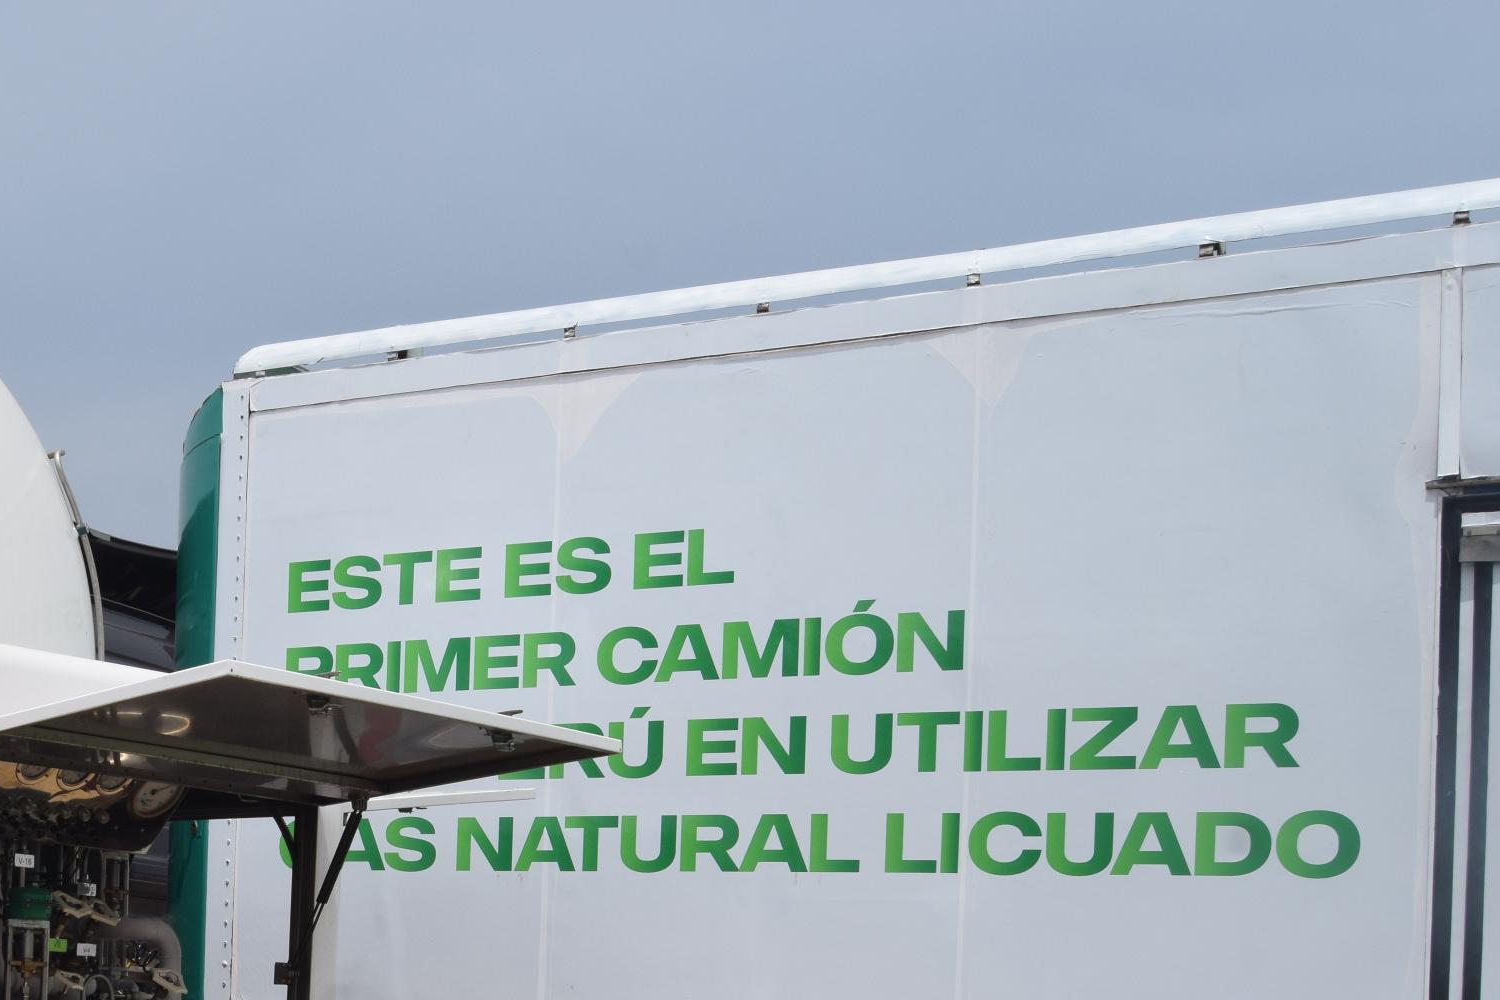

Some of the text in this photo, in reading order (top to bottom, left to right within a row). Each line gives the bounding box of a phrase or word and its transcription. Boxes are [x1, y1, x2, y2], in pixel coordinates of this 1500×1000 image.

[287, 528, 735, 614] ESTE ES EL
[596, 599, 966, 686] CAMIÓN
[686, 716, 807, 776] EN
[830, 702, 1301, 774] UTILIZAR
[278, 810, 1361, 879] AS NATURAL LICUADO
